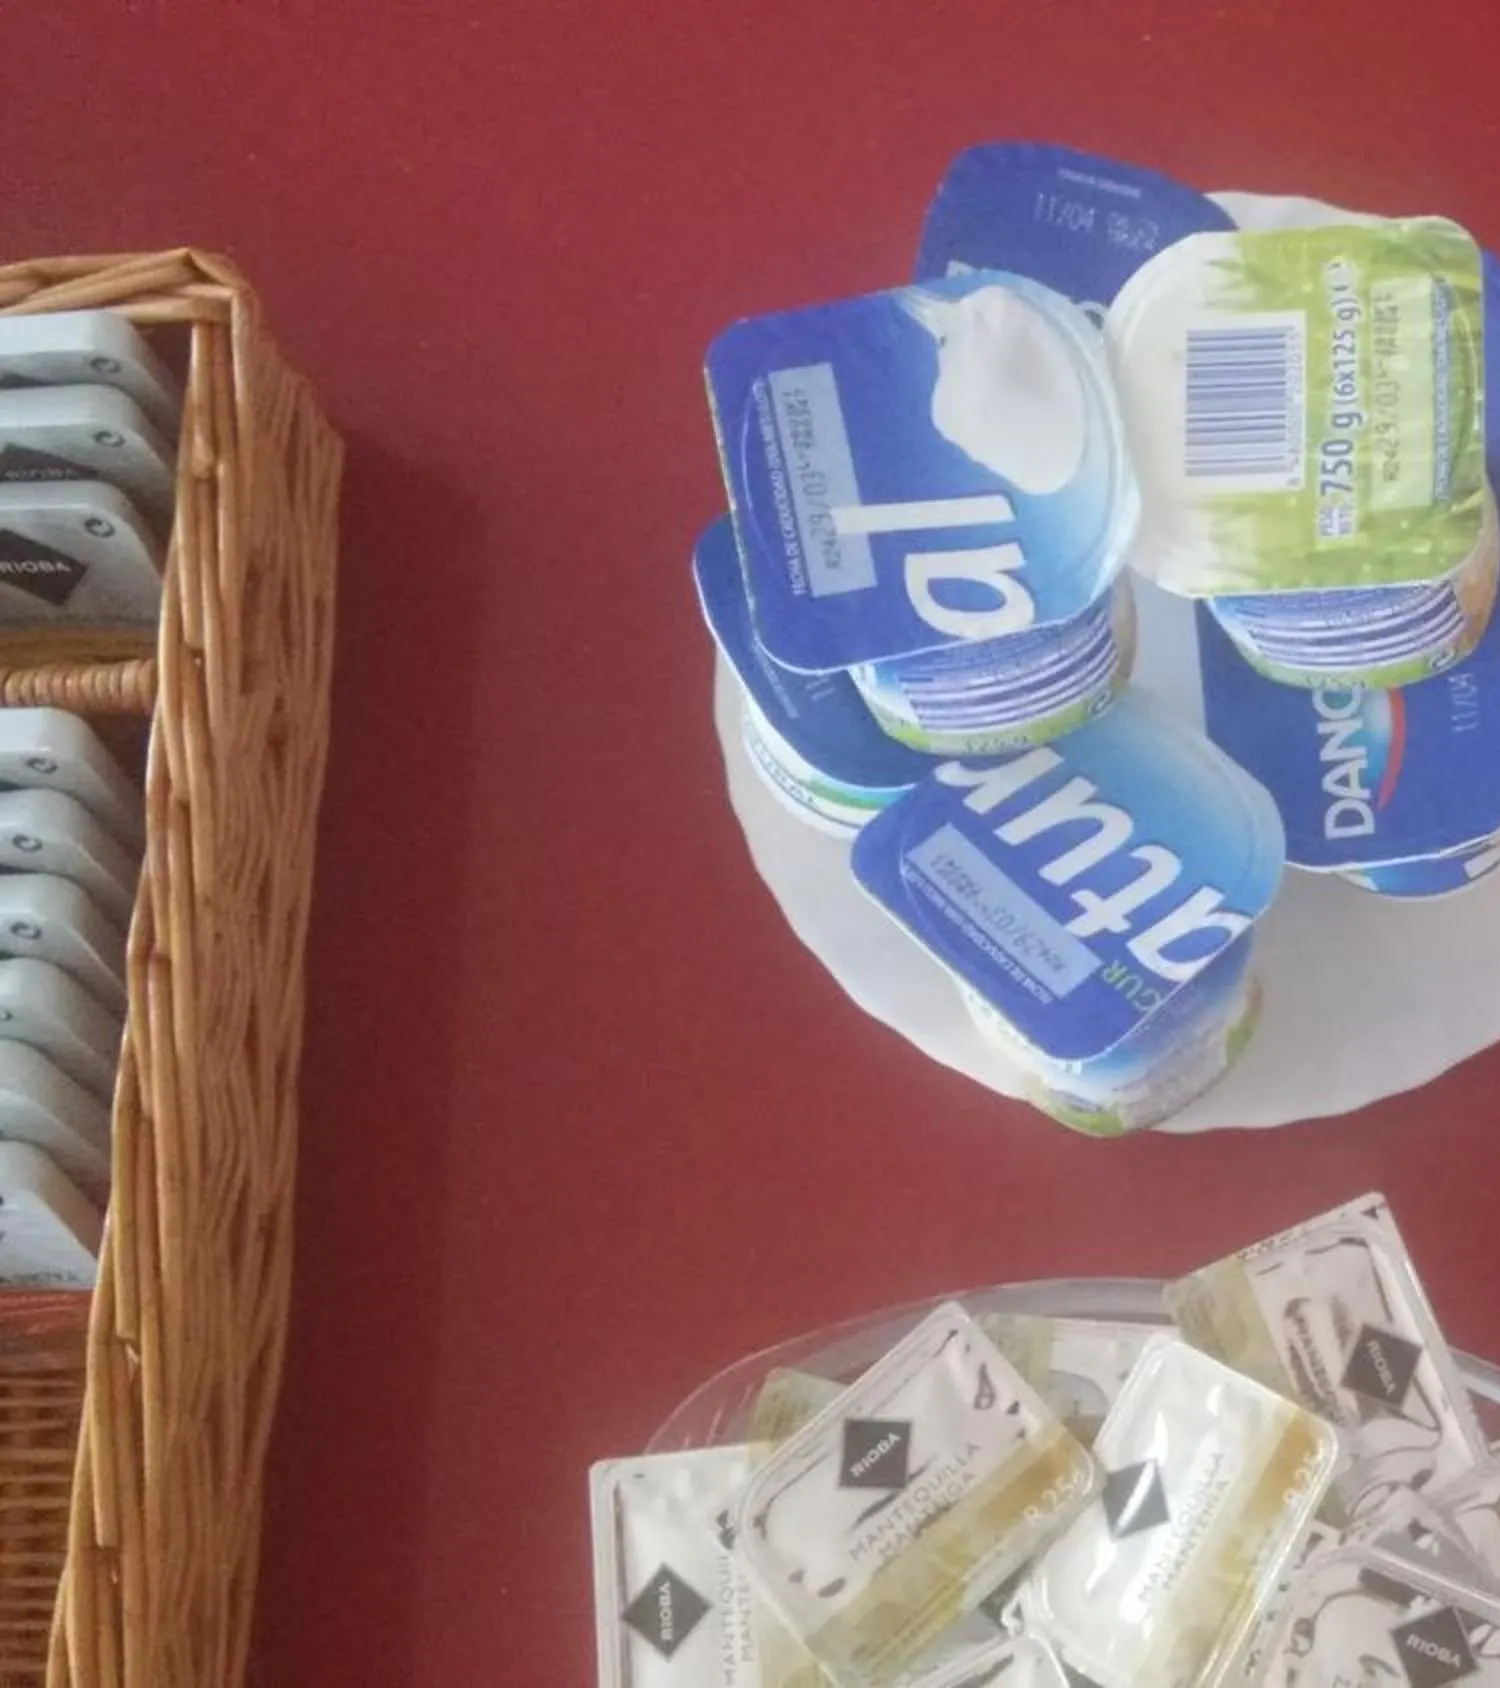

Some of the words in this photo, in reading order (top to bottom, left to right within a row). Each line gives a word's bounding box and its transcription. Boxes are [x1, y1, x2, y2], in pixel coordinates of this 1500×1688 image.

[1331, 412, 1363, 429] g
[1320, 438, 1353, 496] 750
[831, 494, 1037, 640] al
[1366, 1336, 1397, 1395] RIOBA
[850, 1431, 902, 1480] RIOBA
[658, 1579, 673, 1642] RIOBA
[1405, 1633, 1461, 1668] RIOBA
